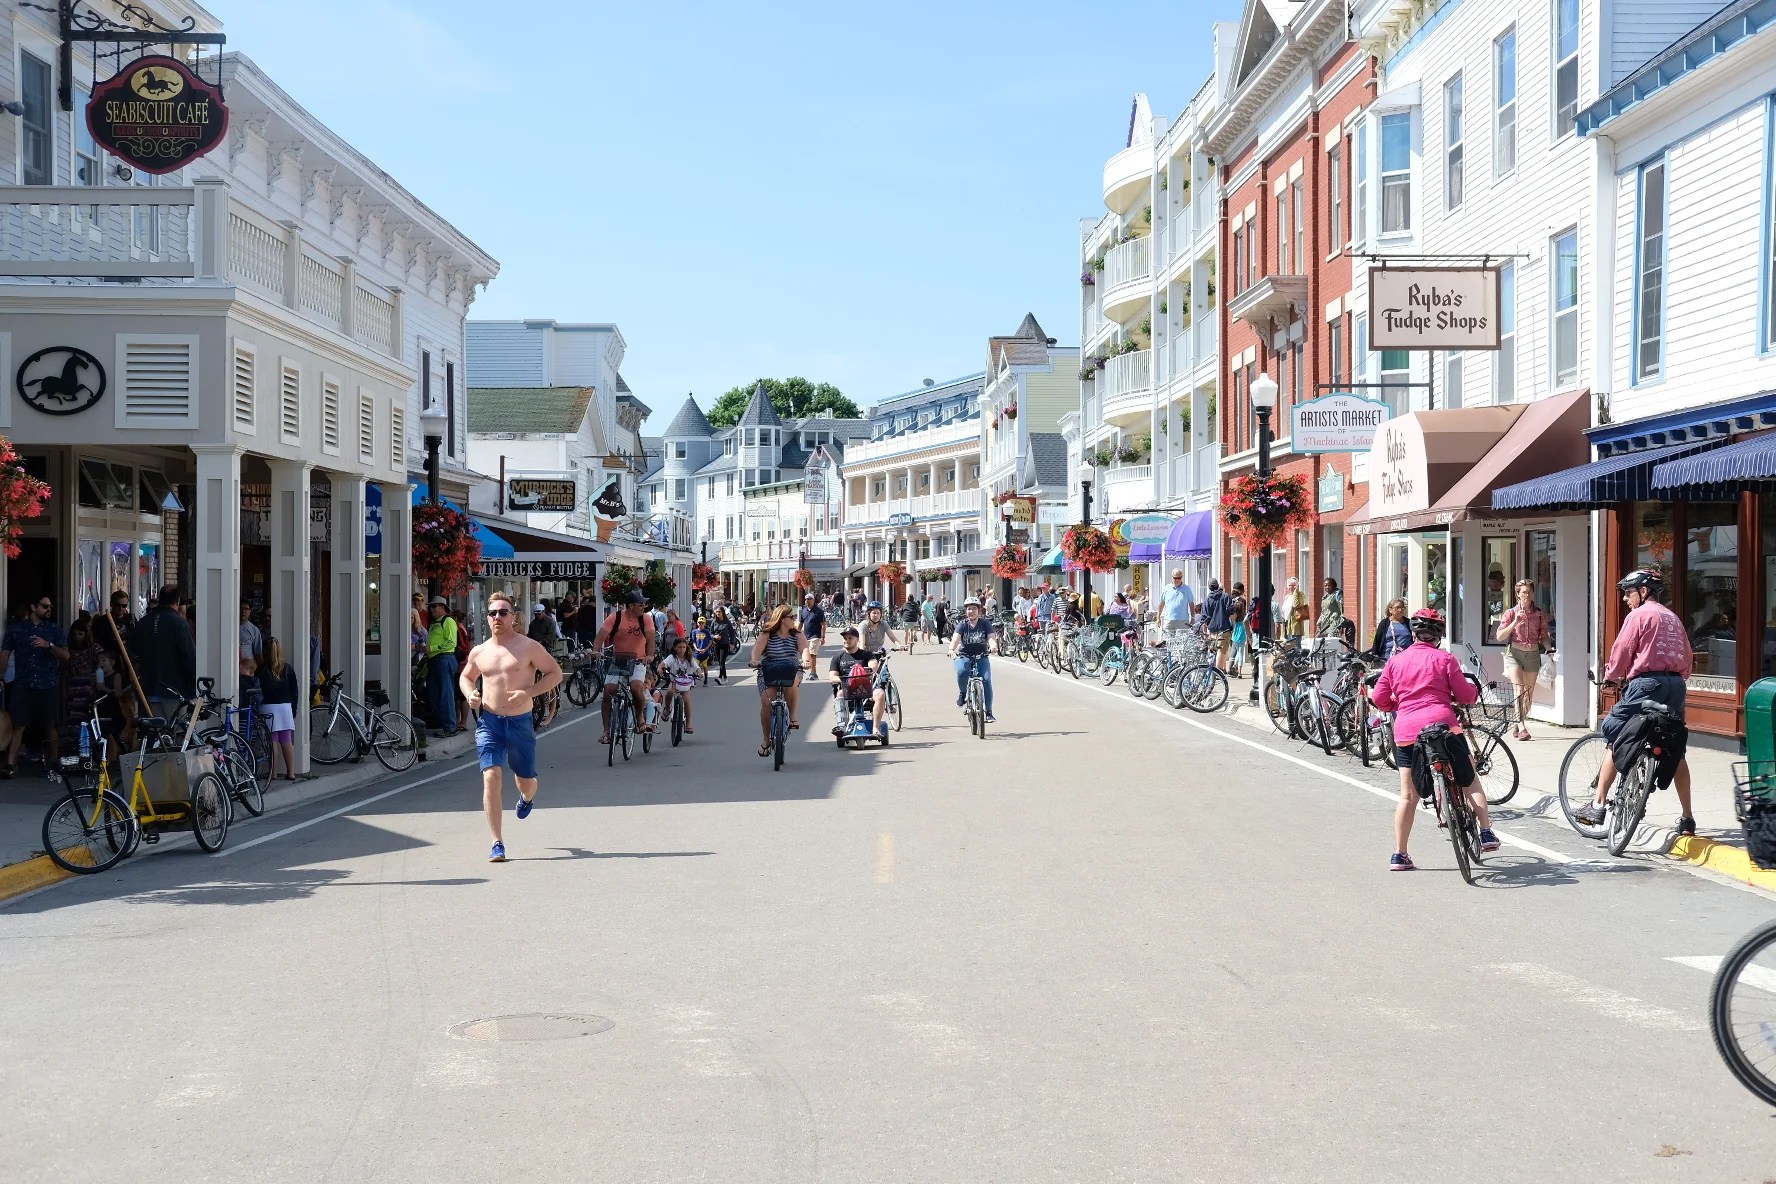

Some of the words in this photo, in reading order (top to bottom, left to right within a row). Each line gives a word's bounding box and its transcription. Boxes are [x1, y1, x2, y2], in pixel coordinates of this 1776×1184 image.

[105, 100, 174, 123] SEABISCUIT
[177, 98, 209, 124] CAFÉ
[1408, 283, 1463, 312] Ryba's
[1381, 308, 1432, 334] Fudge
[1436, 310, 1488, 334] Shops
[1300, 411, 1338, 428] ARTISTS
[1341, 410, 1383, 426] MARKET
[1303, 436, 1350, 446] Mackinac
[1352, 436, 1374, 446] Islan
[1386, 426, 1407, 473] Ryba's
[511, 481, 574, 495] MURDICK'S
[539, 493, 573, 505] FUDGE
[478, 562, 542, 576] MURDICKS
[550, 562, 590, 576] FUDGE
